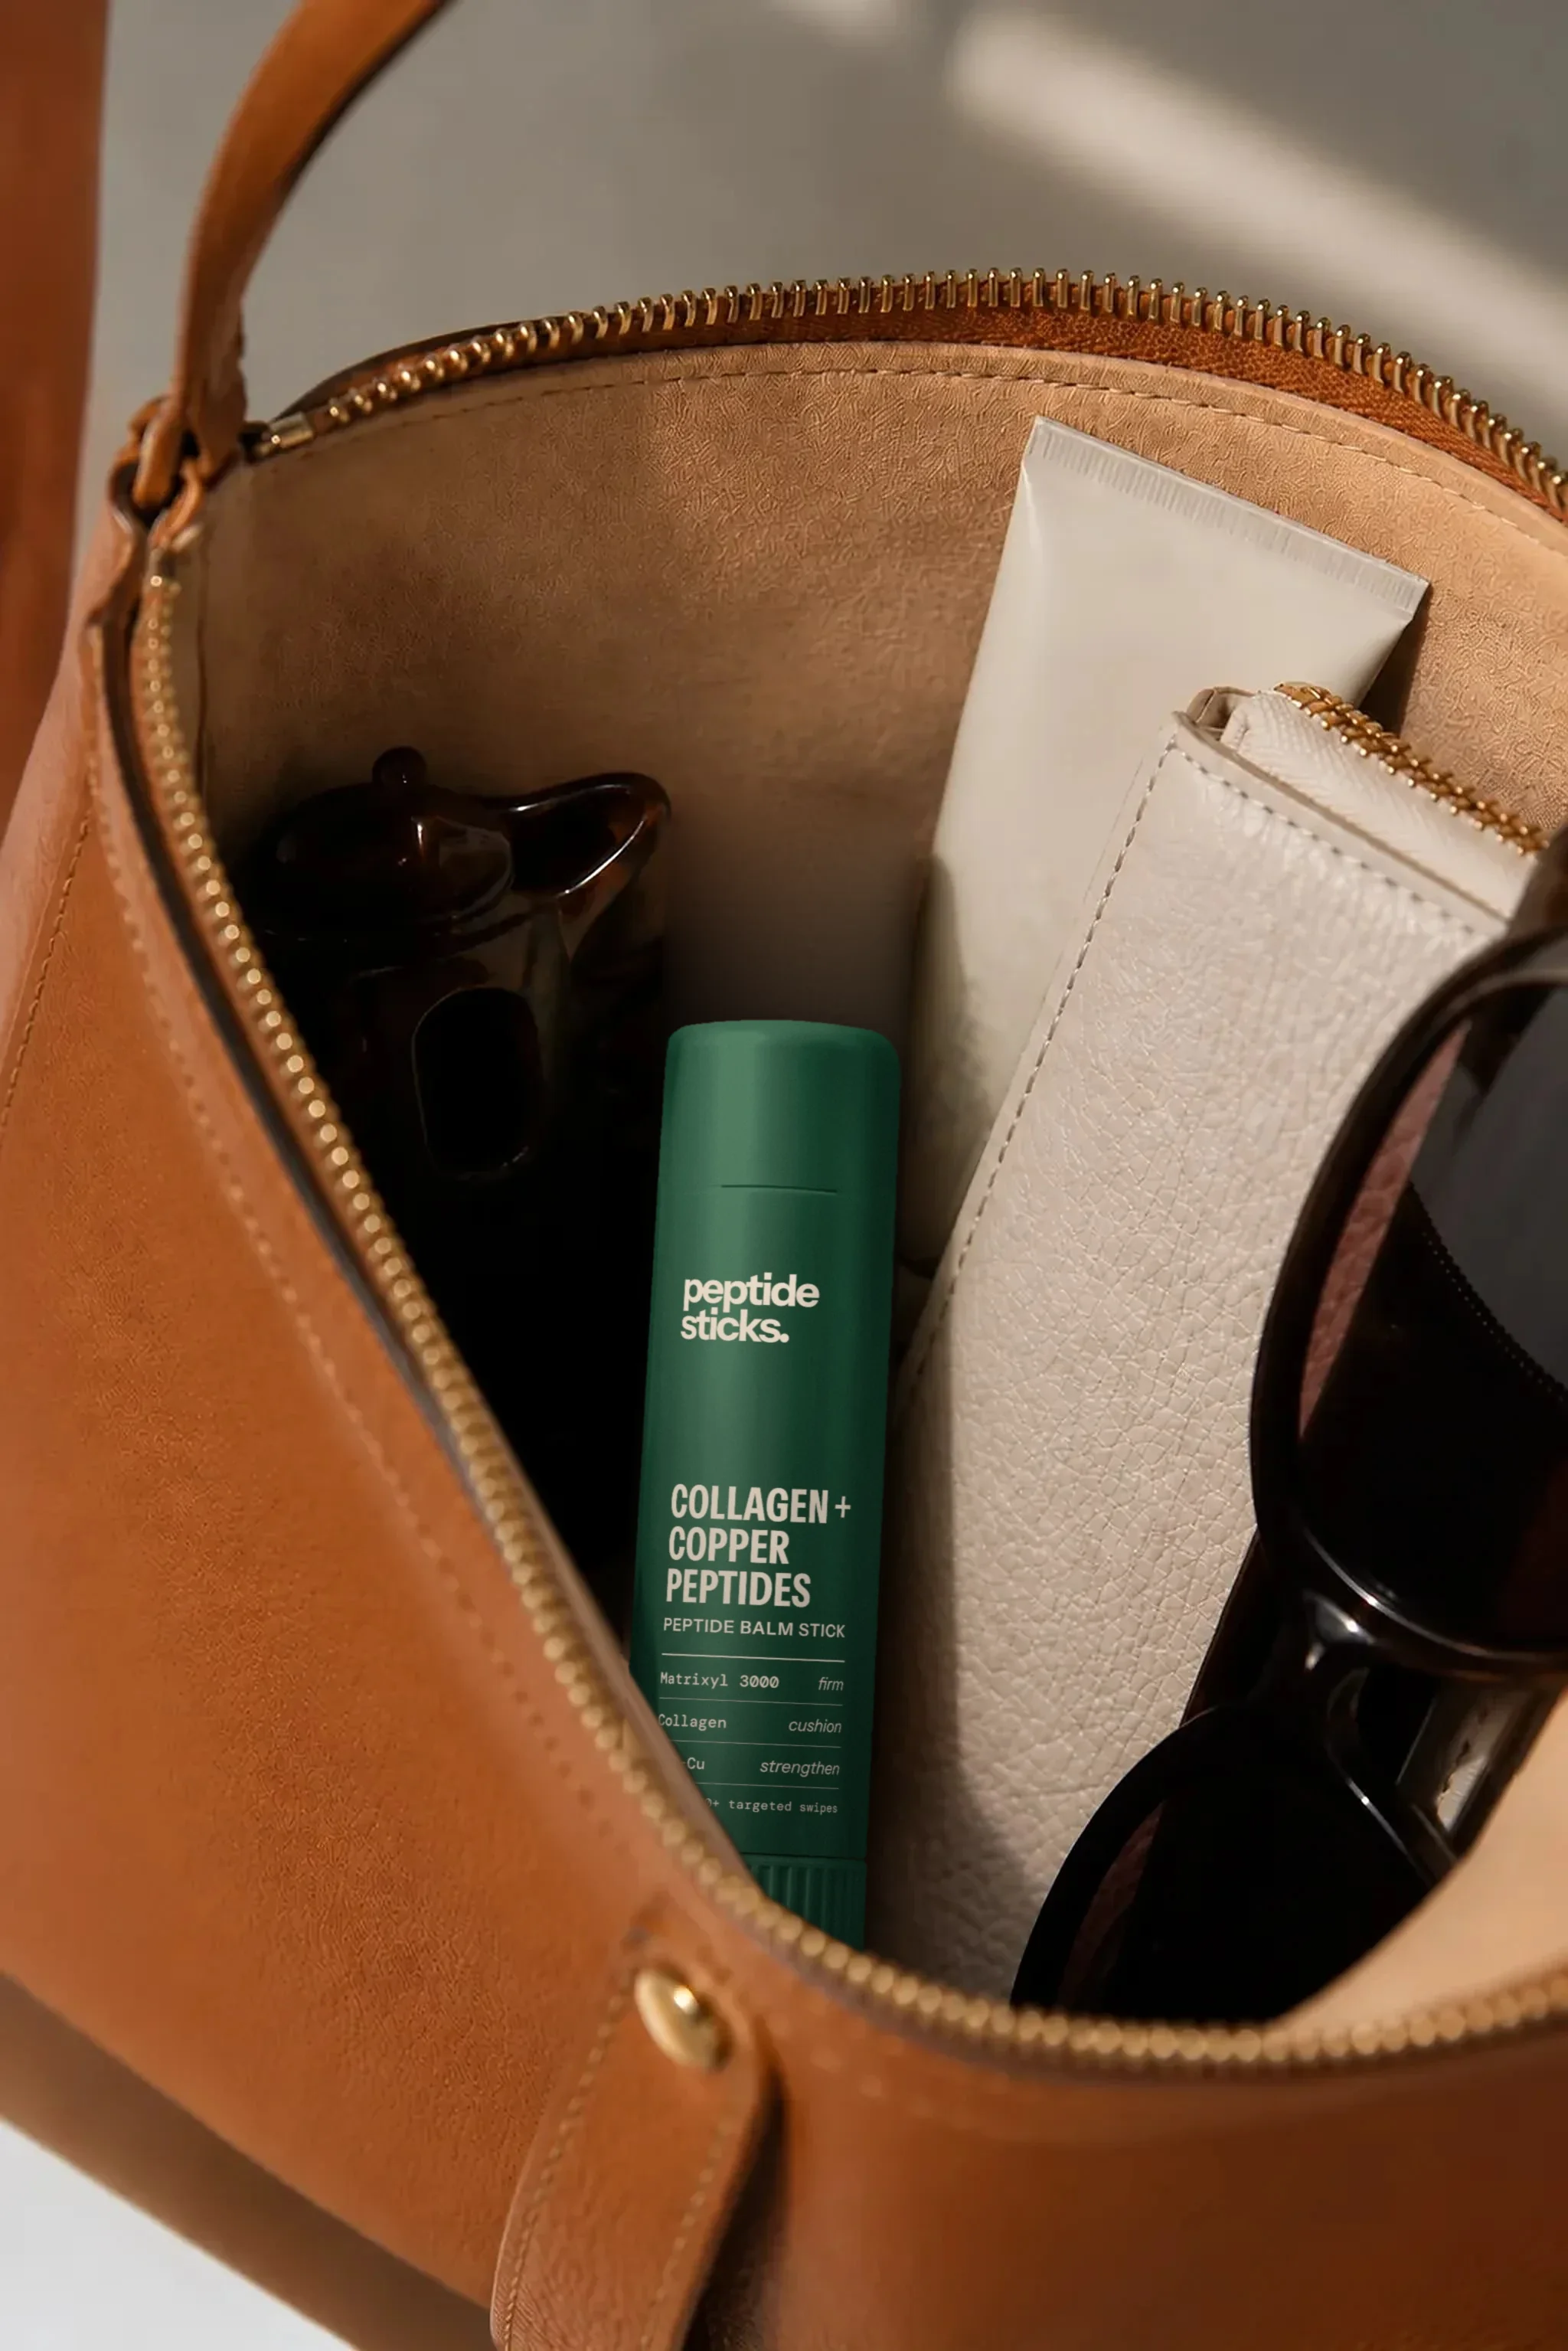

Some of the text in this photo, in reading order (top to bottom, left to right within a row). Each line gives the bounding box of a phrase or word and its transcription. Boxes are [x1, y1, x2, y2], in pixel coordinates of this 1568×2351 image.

[683, 1272, 820, 1313] peptide
[681, 1307, 789, 1342] sticks.
[669, 1526, 789, 1564] COPPER
[667, 1568, 810, 1607] PEPTIDES
[664, 1617, 844, 1637] PEPTIDE BALM STICK
[661, 1673, 779, 1689] Matrixyl 3000
[818, 1677, 844, 1690] firm
[658, 1713, 727, 1731] Collagen
[789, 1719, 841, 1732] cushion
[760, 1761, 839, 1777] strengthen
[729, 1800, 792, 1812] targeted
[800, 1803, 837, 1815] swipes
